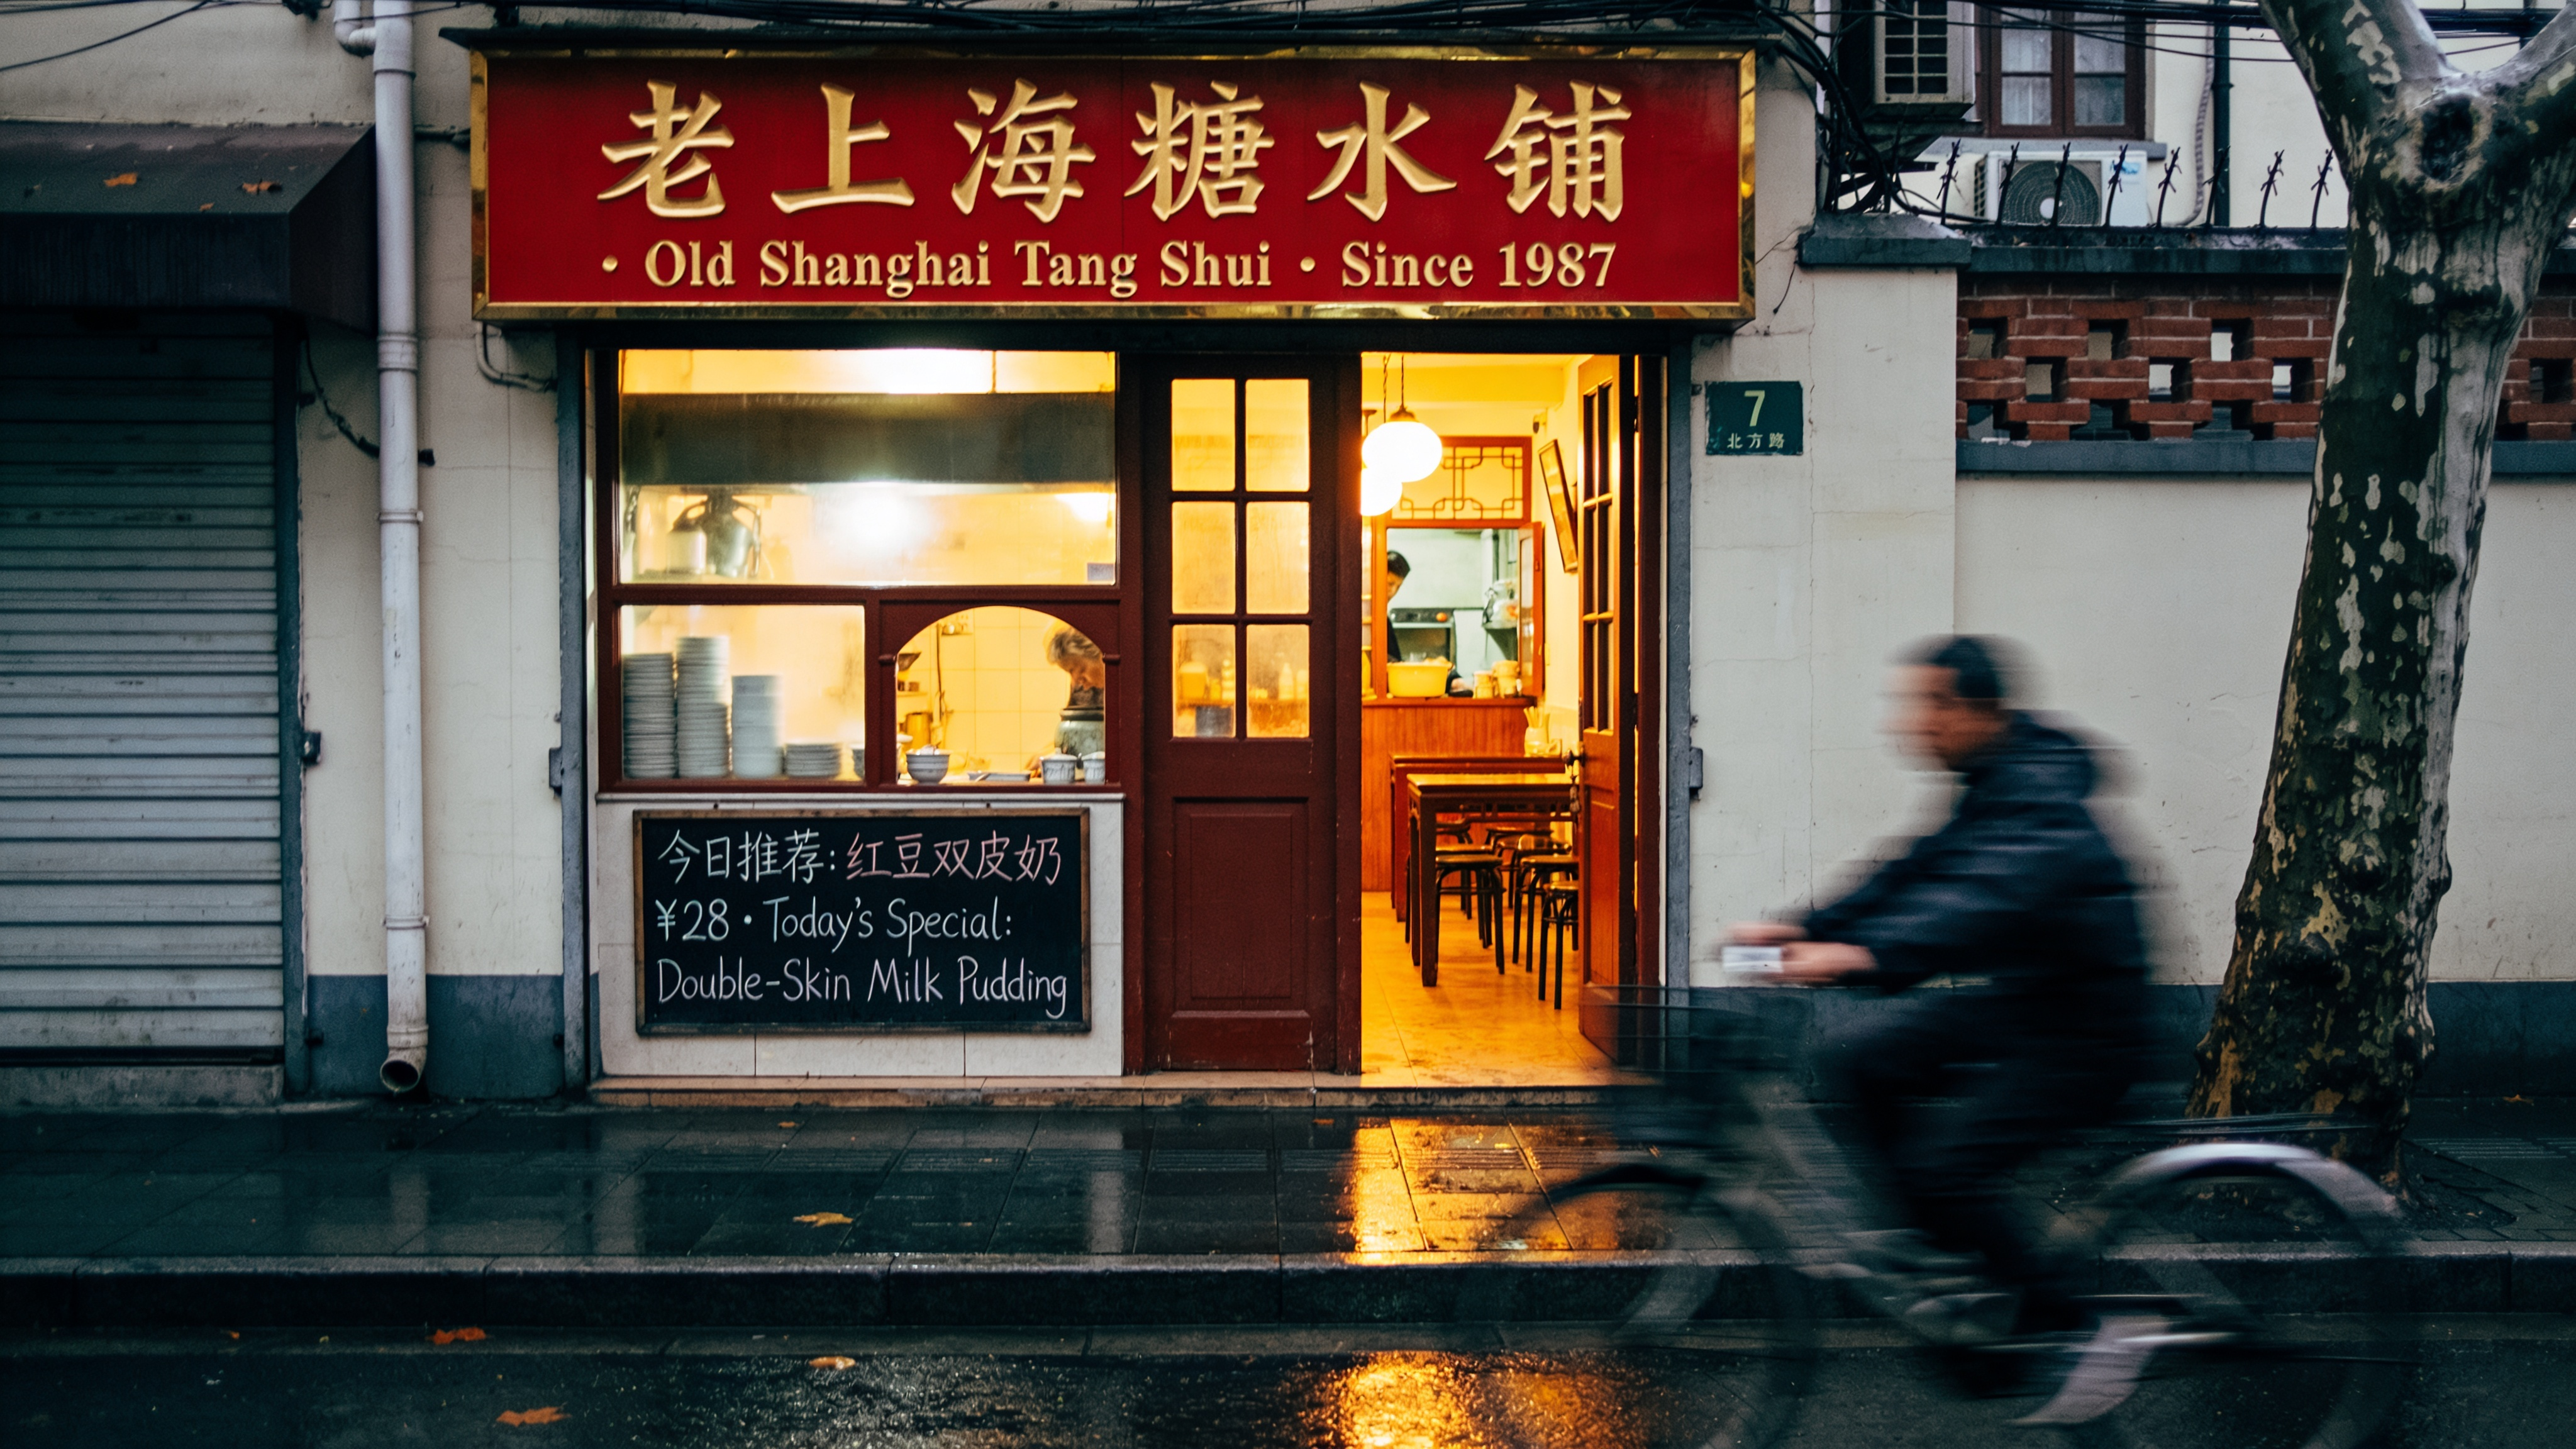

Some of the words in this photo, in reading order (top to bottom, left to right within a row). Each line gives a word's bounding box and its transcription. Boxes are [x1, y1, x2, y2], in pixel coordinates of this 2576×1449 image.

[597, 79, 1633, 223] 老上海糖水铺
[645, 240, 736, 287] Old
[760, 240, 992, 299] Shanghai
[1014, 240, 1138, 299] Tang
[1160, 240, 1272, 287] Shui
[1341, 241, 1474, 287] Since
[1499, 241, 1616, 287] 1987
[1744, 390, 1765, 427] 7
[655, 897, 730, 942] ¥28
[762, 896, 874, 953] Today's
[886, 896, 1013, 958] Special:
[657, 955, 851, 1003] Double-Skin
[867, 956, 943, 1003] Milk
[957, 955, 1067, 1019] Pudding
